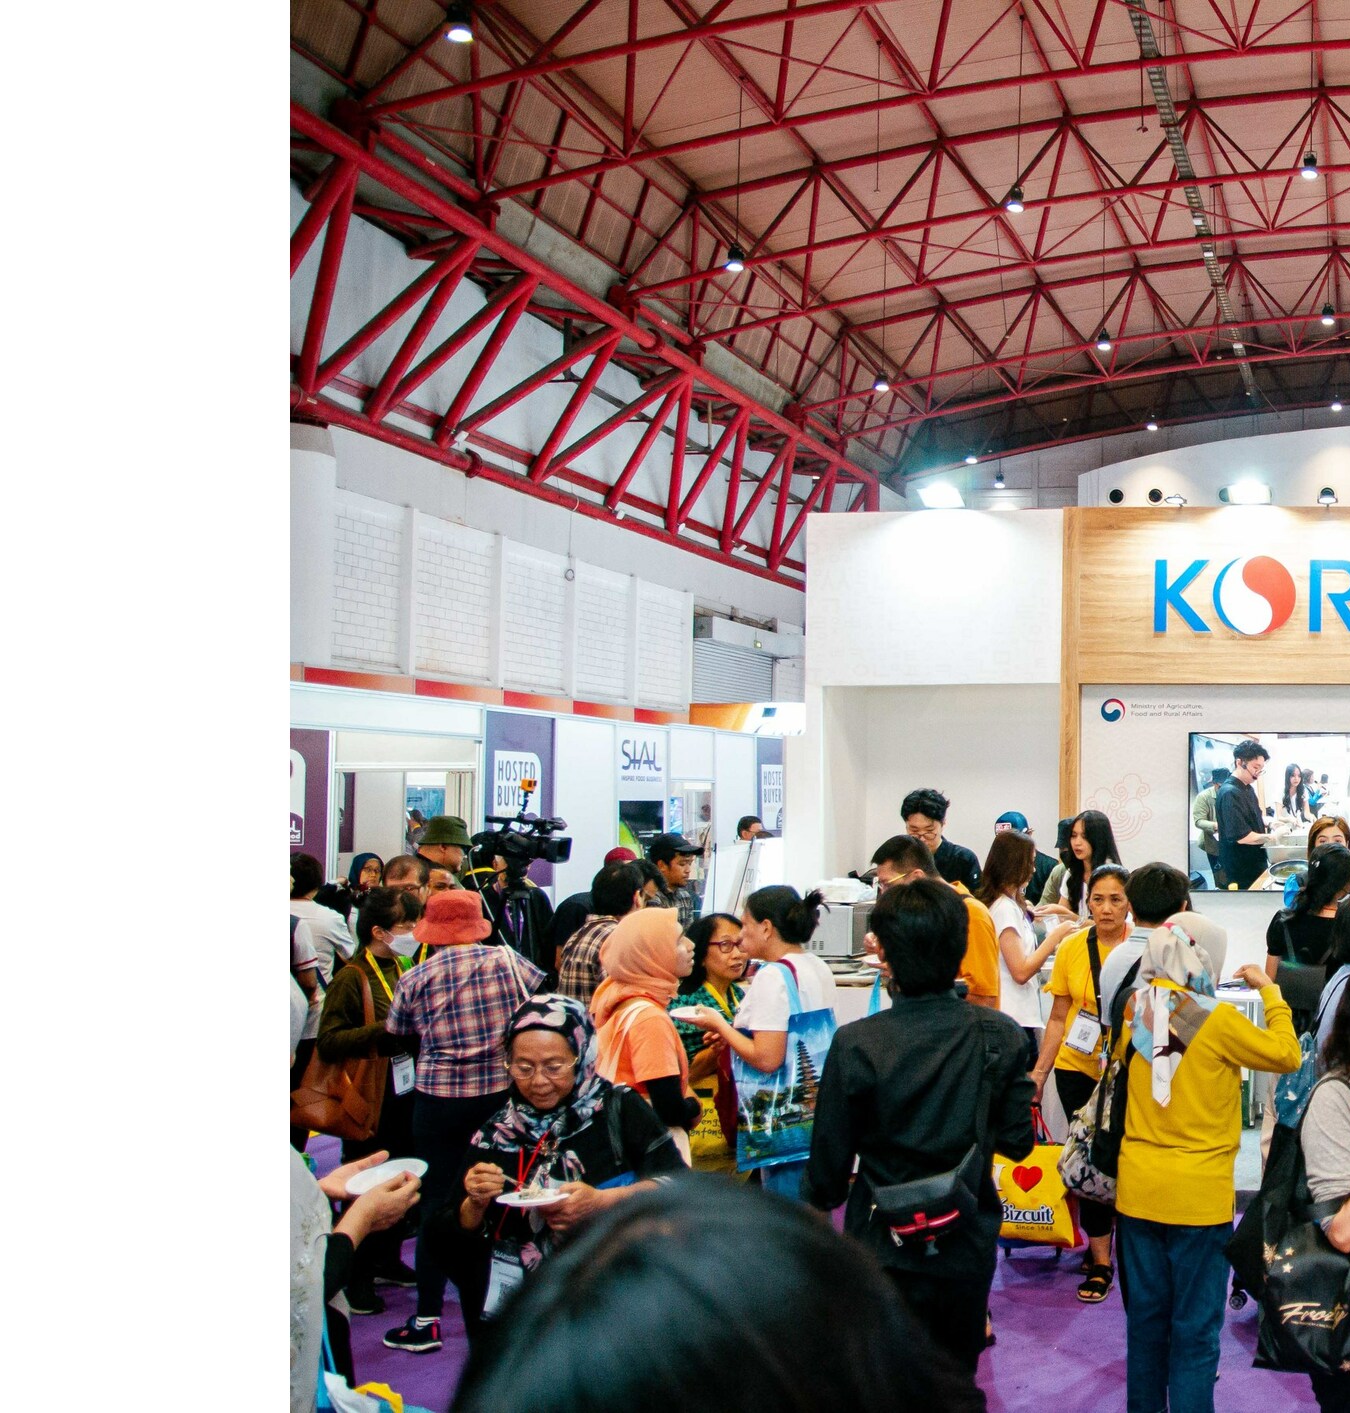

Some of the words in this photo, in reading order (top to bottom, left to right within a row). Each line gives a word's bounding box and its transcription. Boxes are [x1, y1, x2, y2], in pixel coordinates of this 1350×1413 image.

[621, 739, 662, 772] SIAL
[497, 760, 536, 781] HOSTED
[763, 771, 783, 787] HOSTE
[497, 785, 523, 807] BUYE
[1002, 1203, 1054, 1224] Bizcuit
